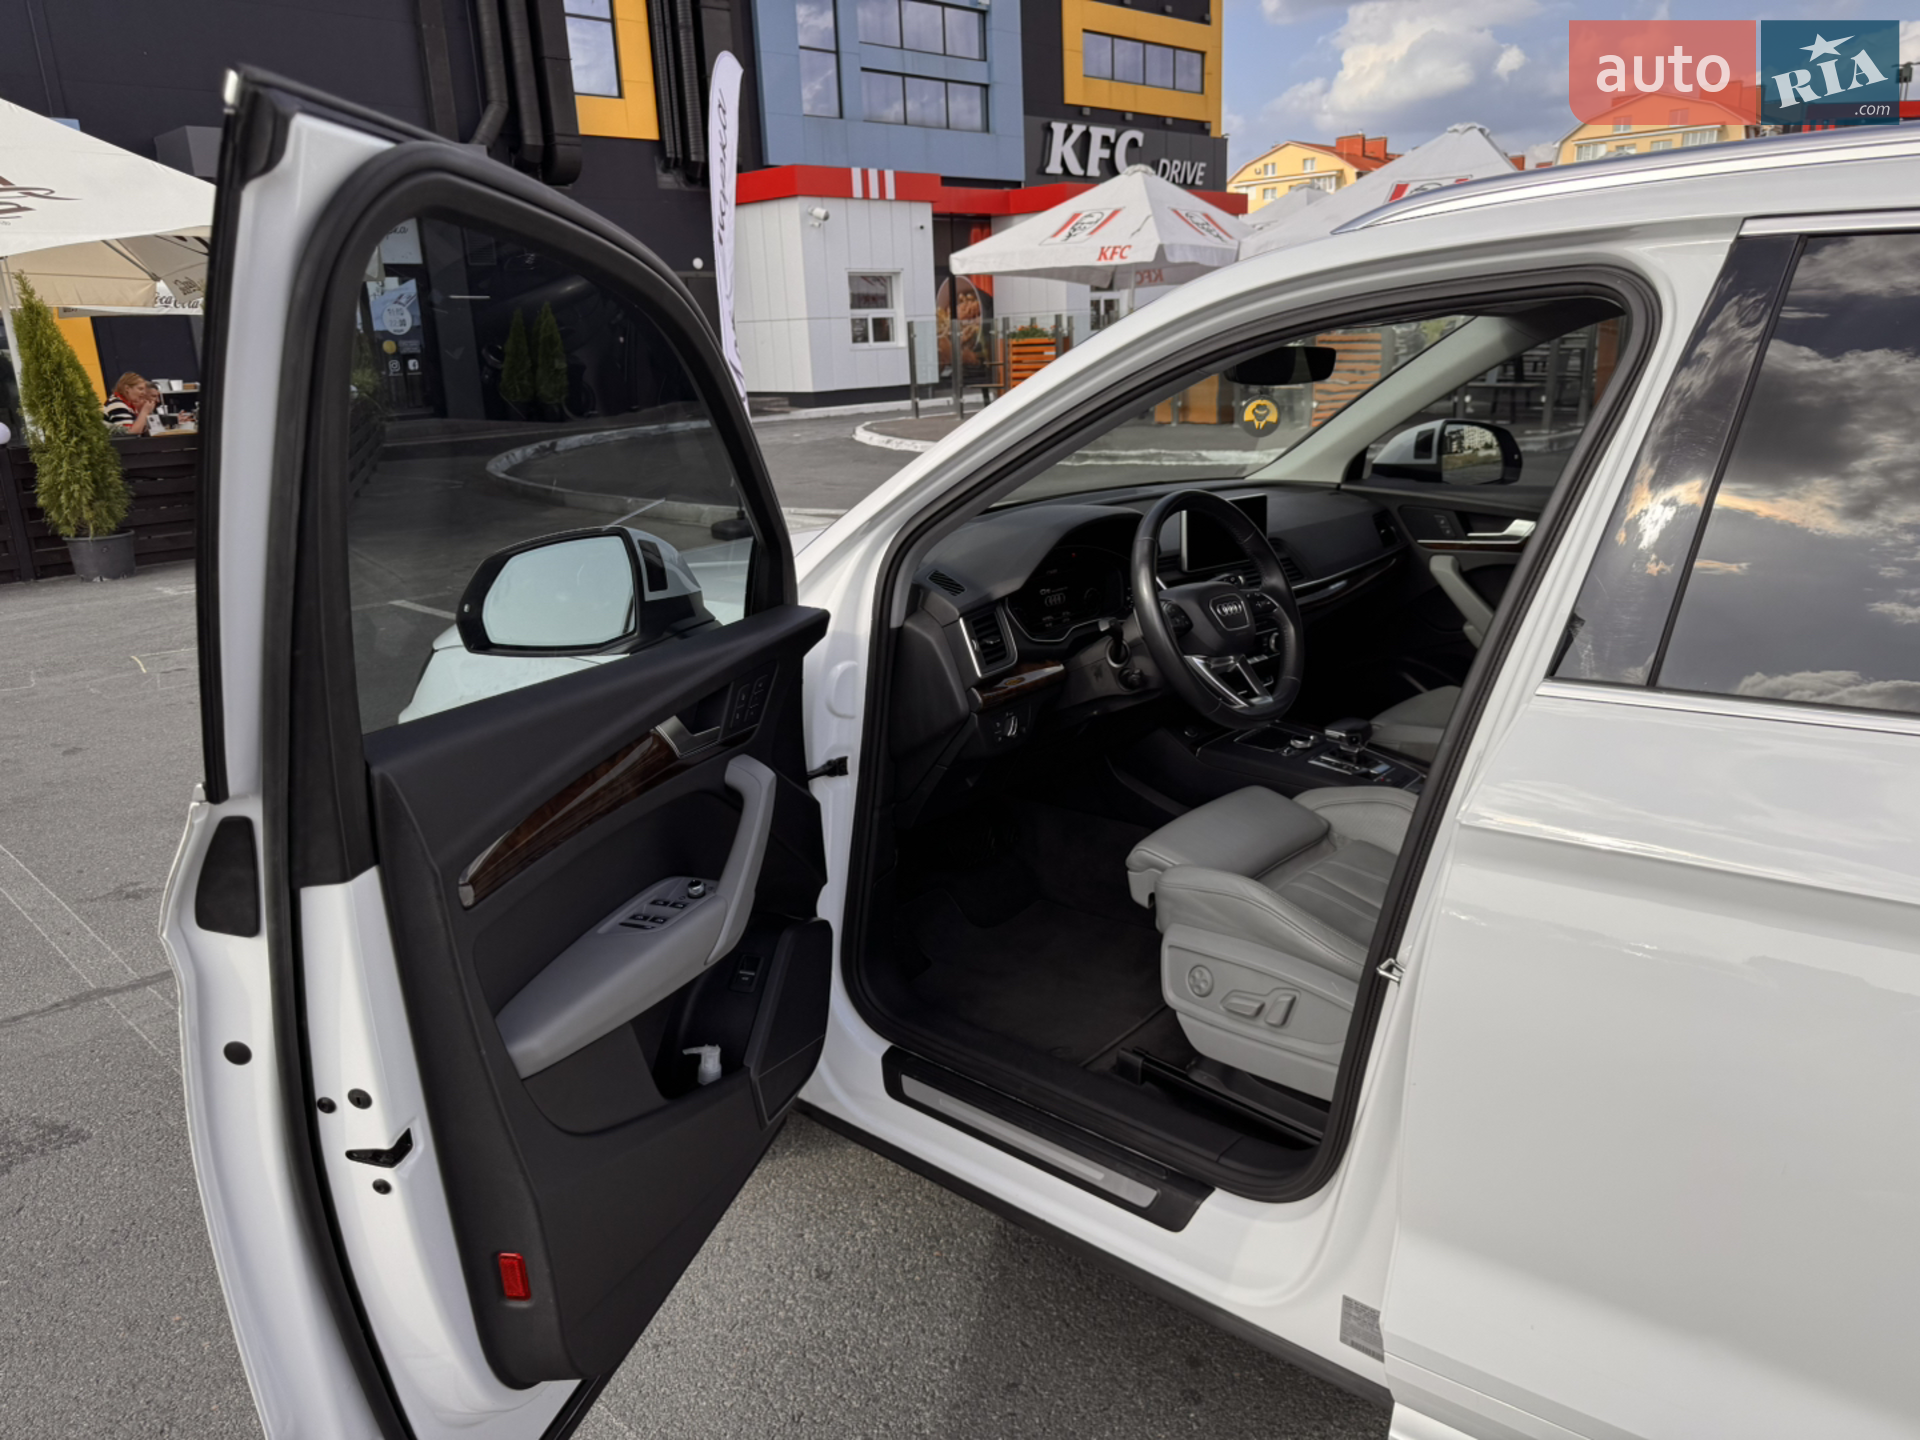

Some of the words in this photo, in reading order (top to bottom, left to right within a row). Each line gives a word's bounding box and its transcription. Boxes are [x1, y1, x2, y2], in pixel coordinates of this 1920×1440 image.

[1045, 121, 1145, 177] KFC
[1157, 158, 1207, 186] DRIVE
[1096, 245, 1132, 262] KFC
